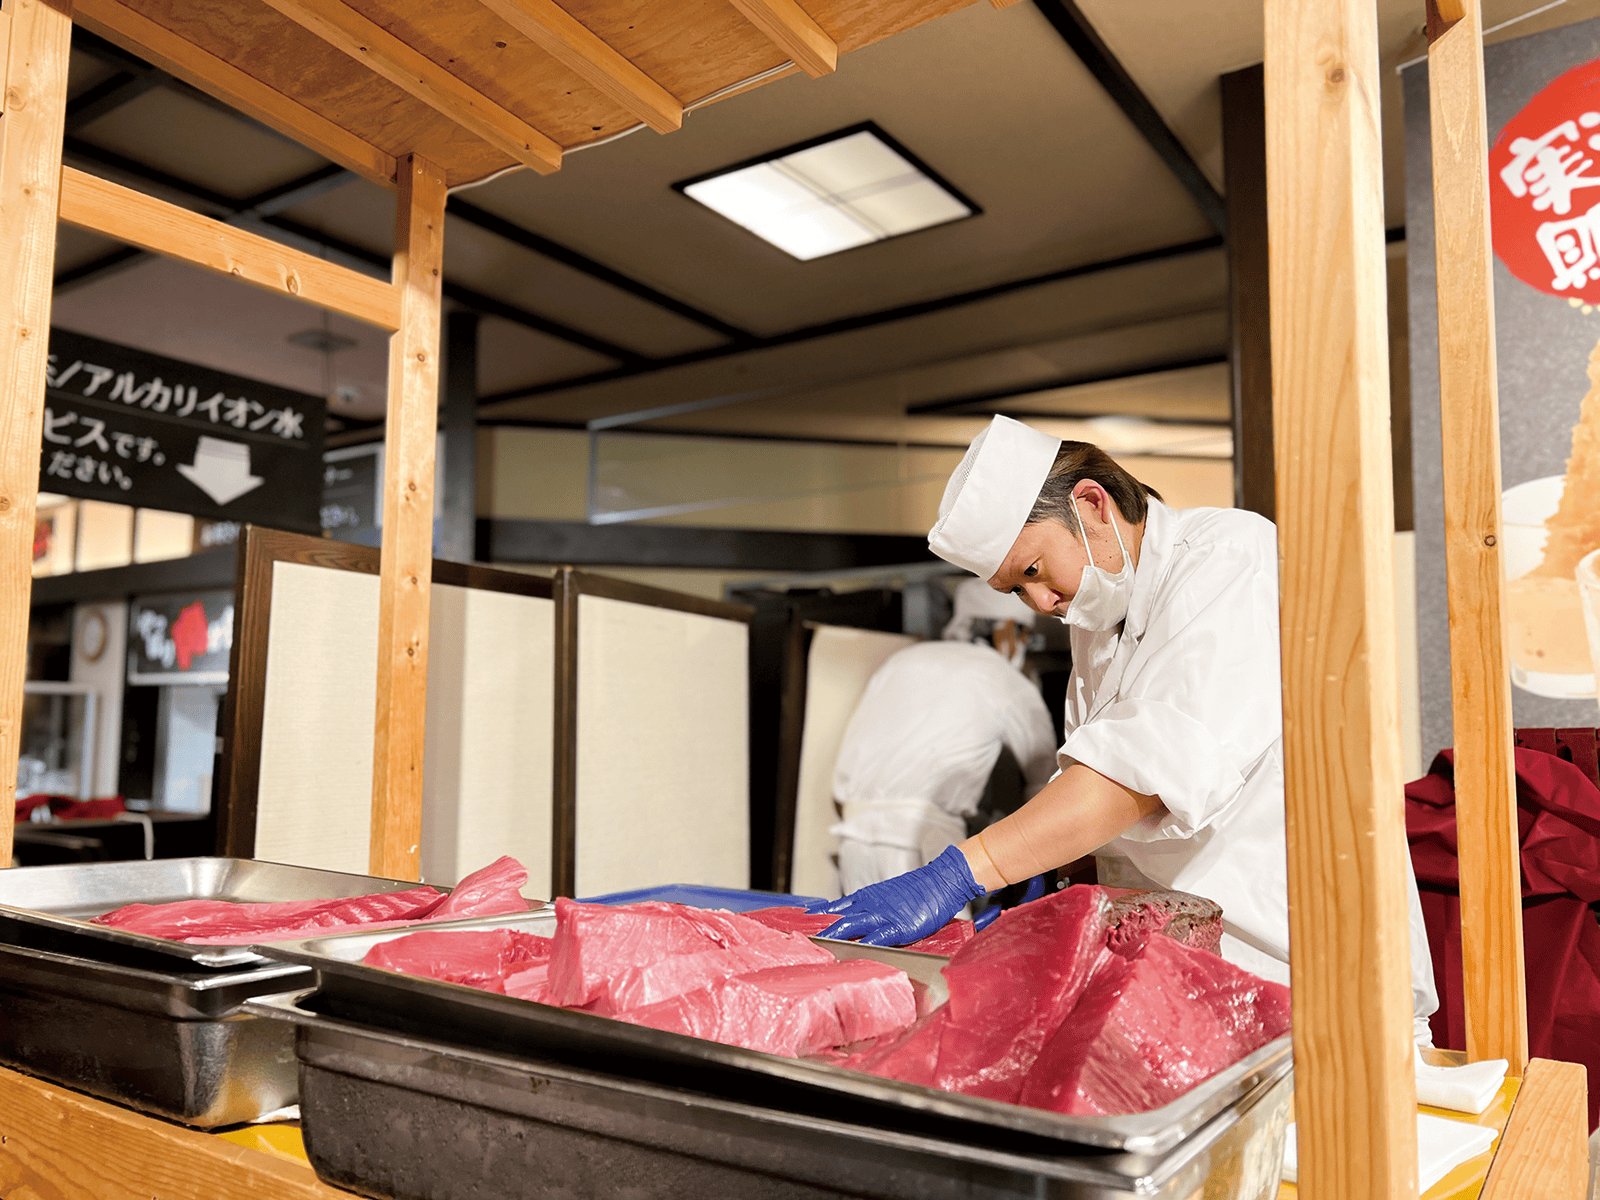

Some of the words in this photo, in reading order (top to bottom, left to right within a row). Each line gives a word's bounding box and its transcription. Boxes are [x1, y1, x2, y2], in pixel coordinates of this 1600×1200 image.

[1500, 111, 1600, 215] 実
[43, 407, 166, 467] ビスです。
[40, 449, 133, 491] ださい。
